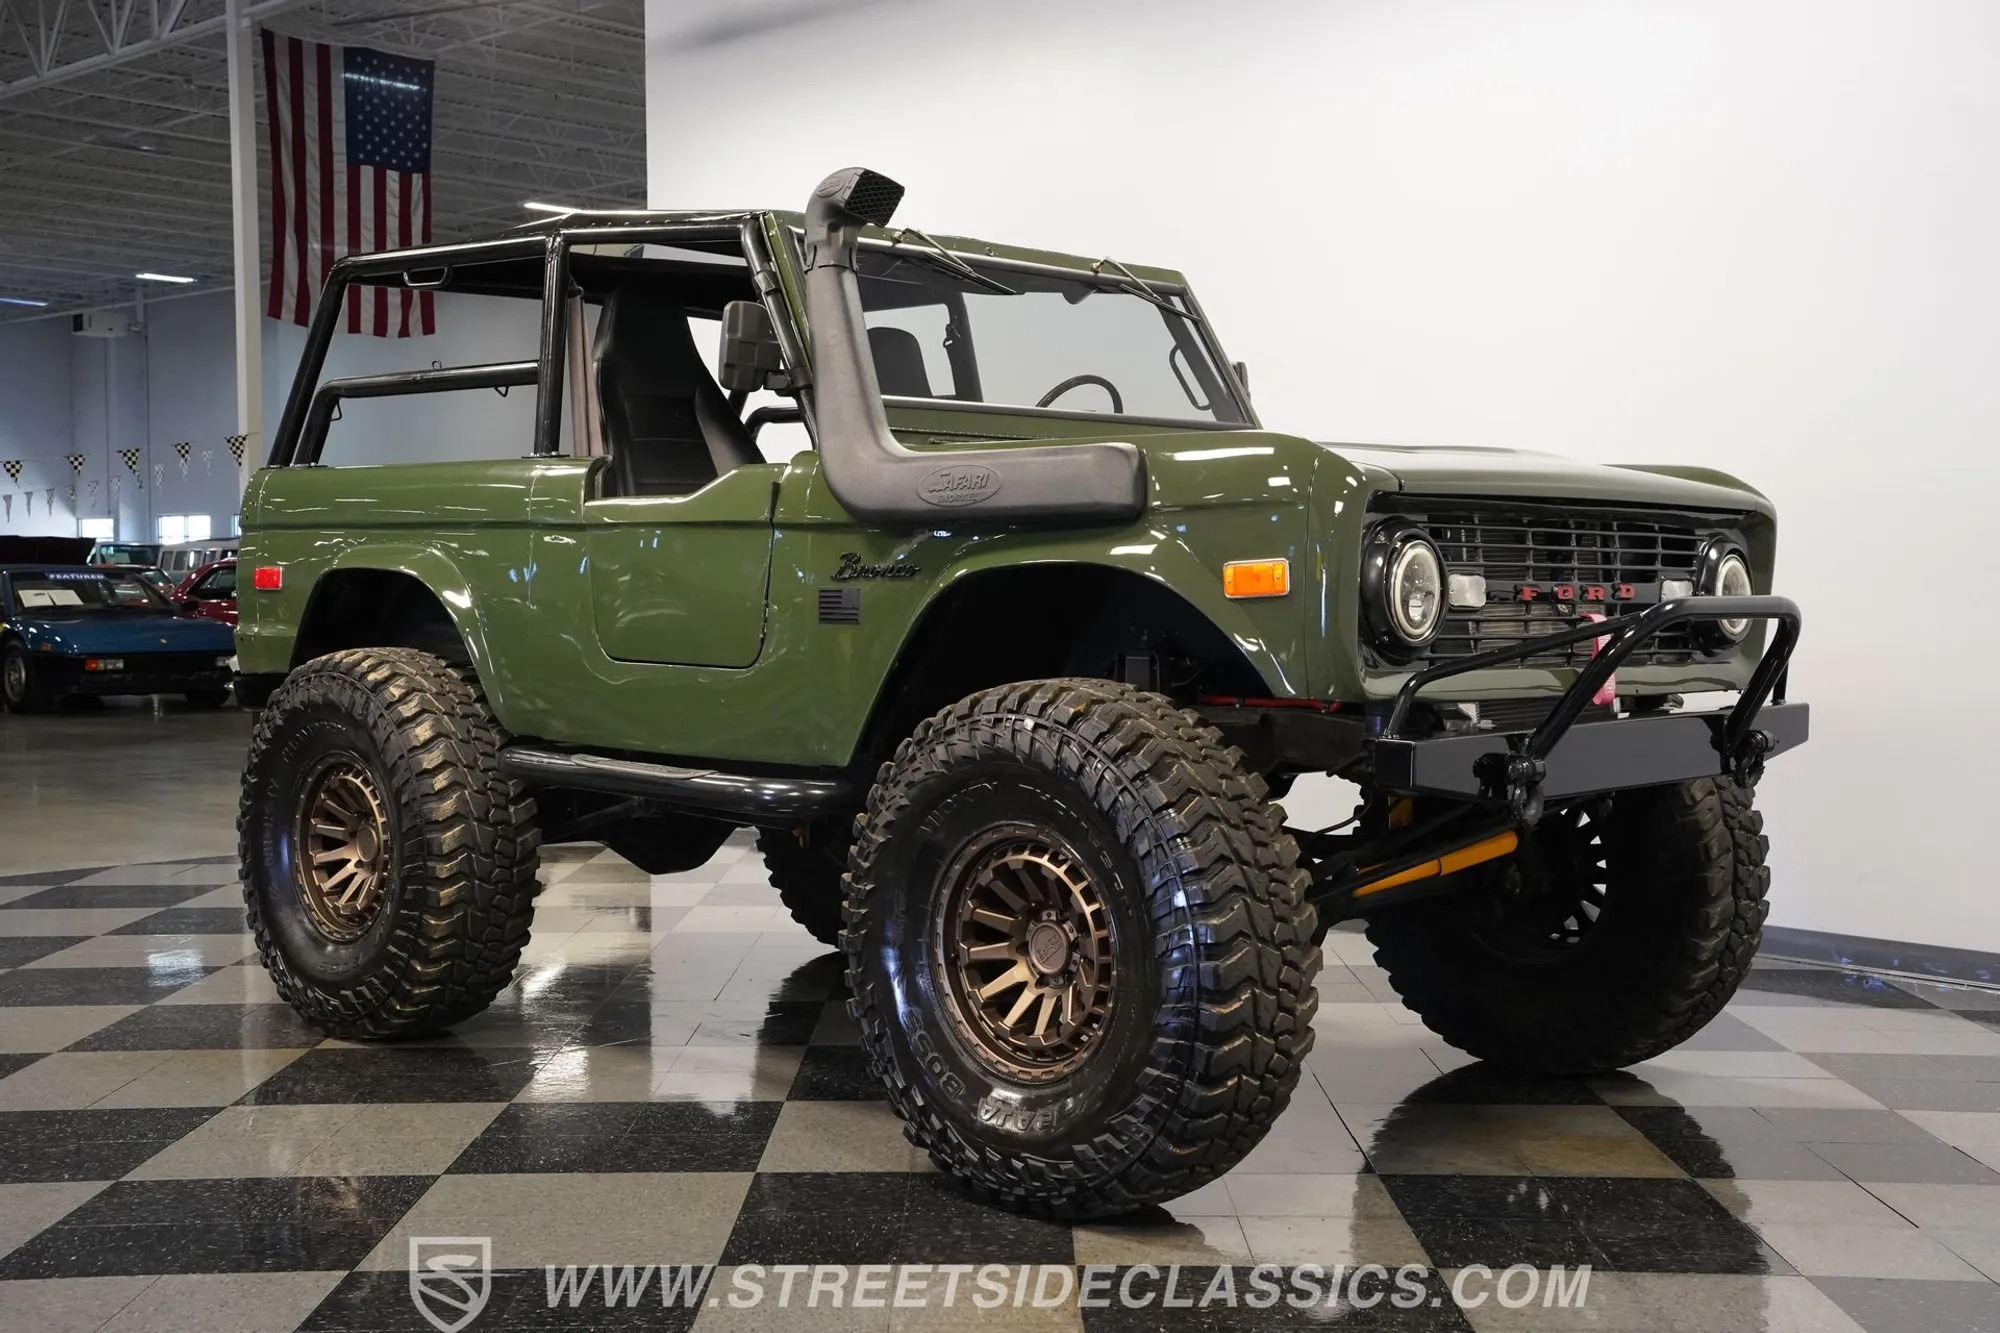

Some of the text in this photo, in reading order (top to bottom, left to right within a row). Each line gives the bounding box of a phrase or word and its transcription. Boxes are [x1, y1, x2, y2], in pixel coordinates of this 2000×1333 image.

[928, 472, 990, 493] SAFARI
[831, 552, 922, 582] Bronco
[1517, 583, 1636, 602] FORD
